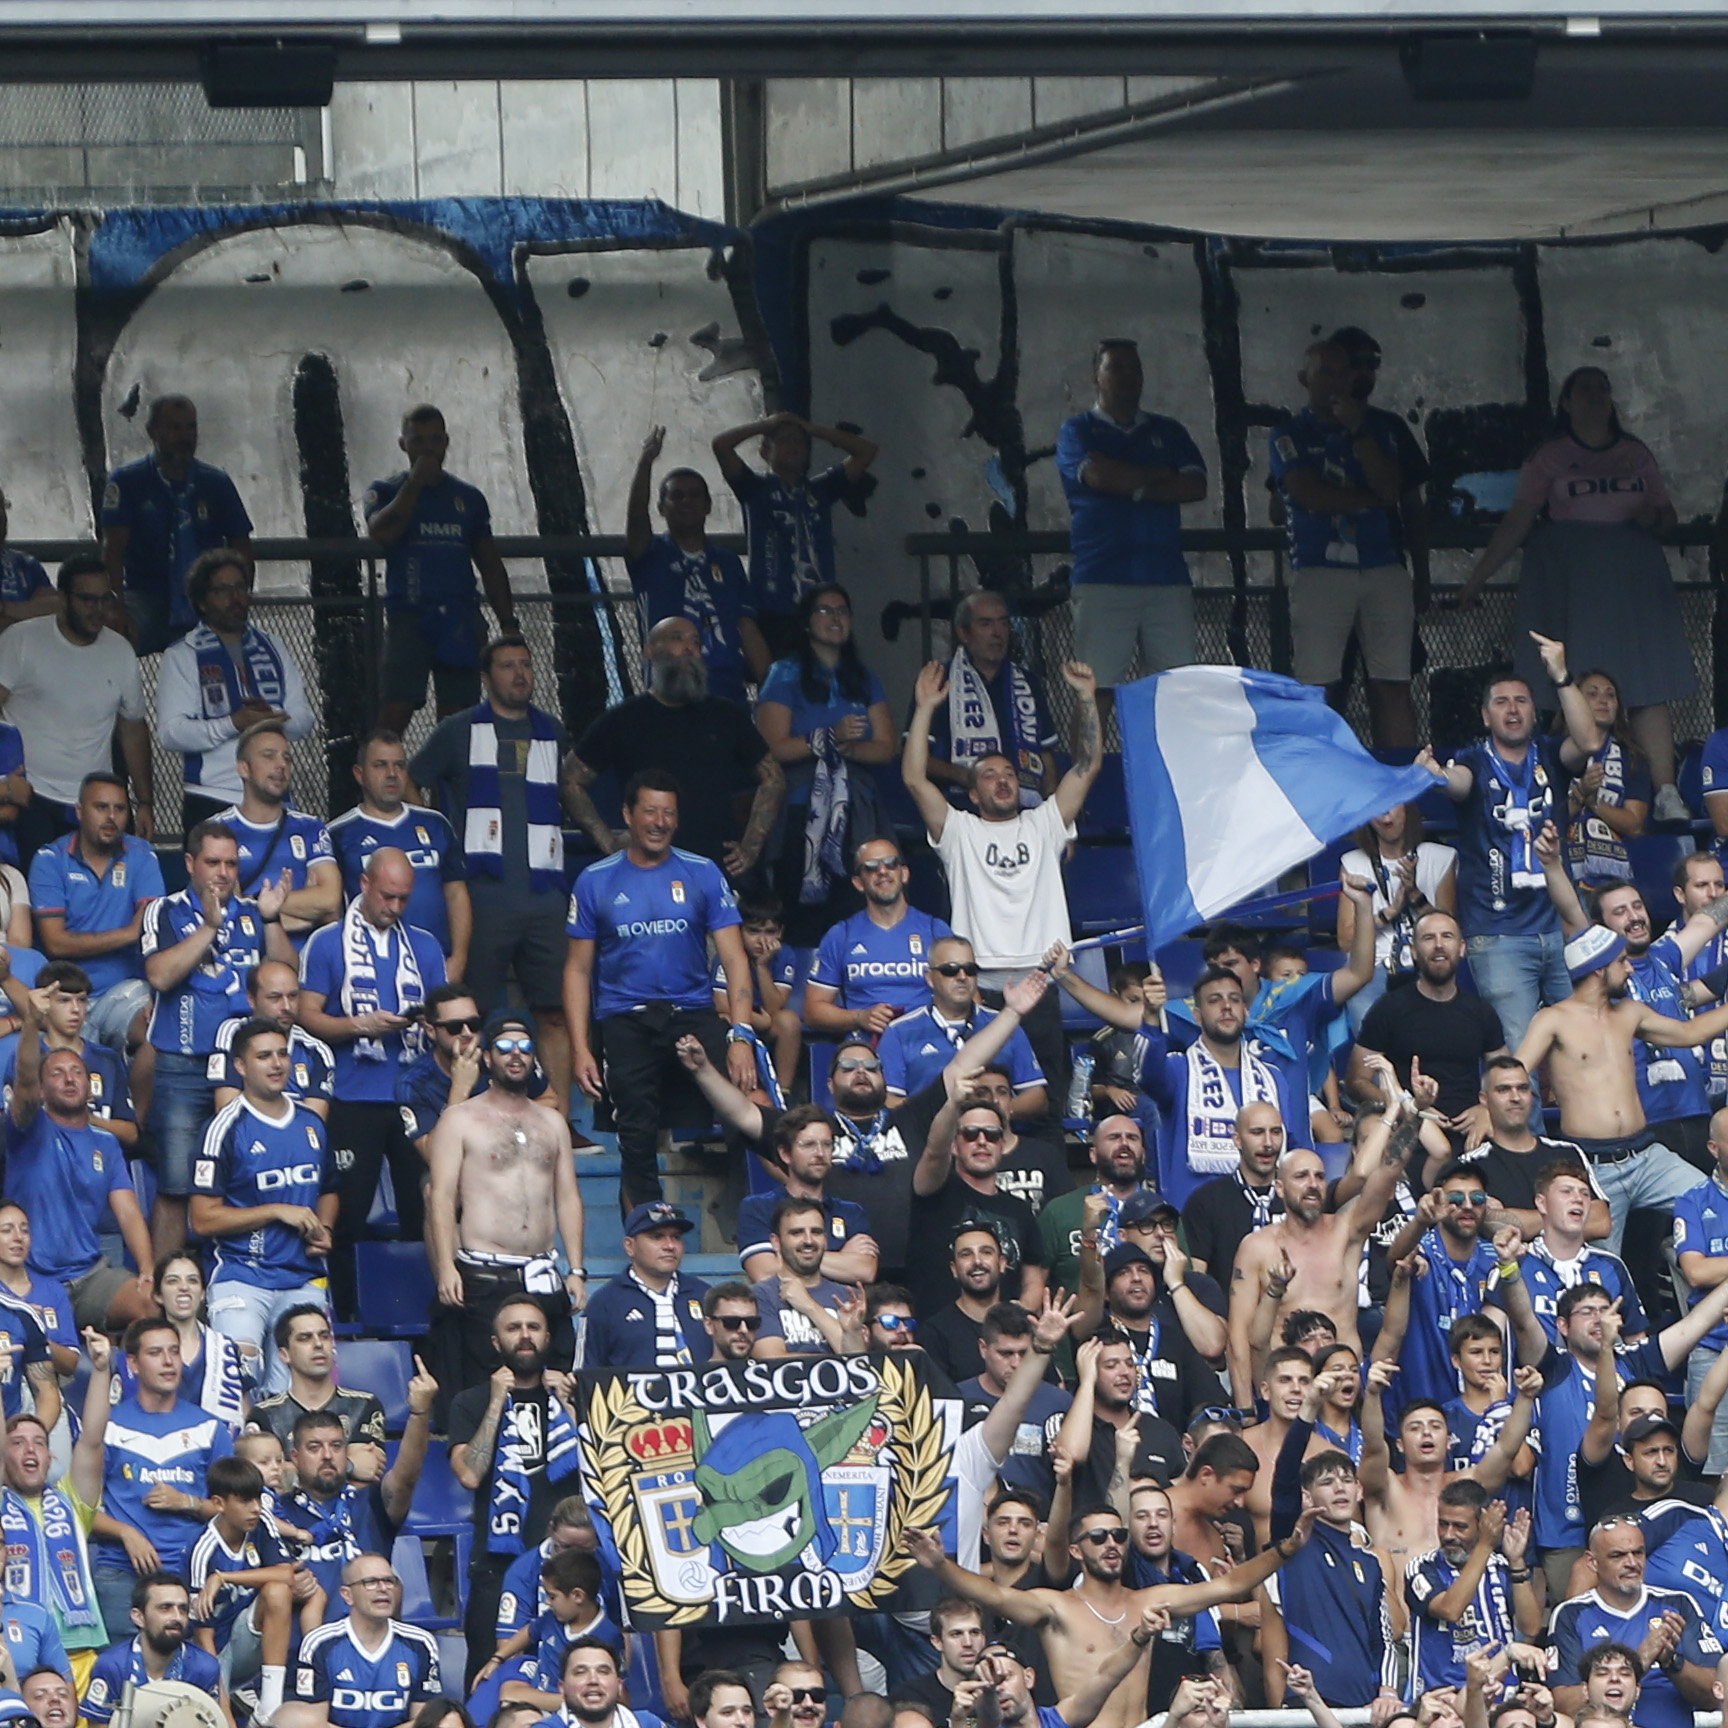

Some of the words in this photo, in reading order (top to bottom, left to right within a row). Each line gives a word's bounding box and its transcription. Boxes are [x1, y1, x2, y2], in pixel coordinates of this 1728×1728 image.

[1567, 478, 1645, 498] DIGI
[419, 522, 462, 538] NMR
[630, 919, 689, 938] OVIEDO
[628, 1355, 880, 1411] TRASGOS
[657, 1471, 686, 1488] RO
[712, 1569, 846, 1622] FIRM
[332, 1686, 409, 1710] DIGI
